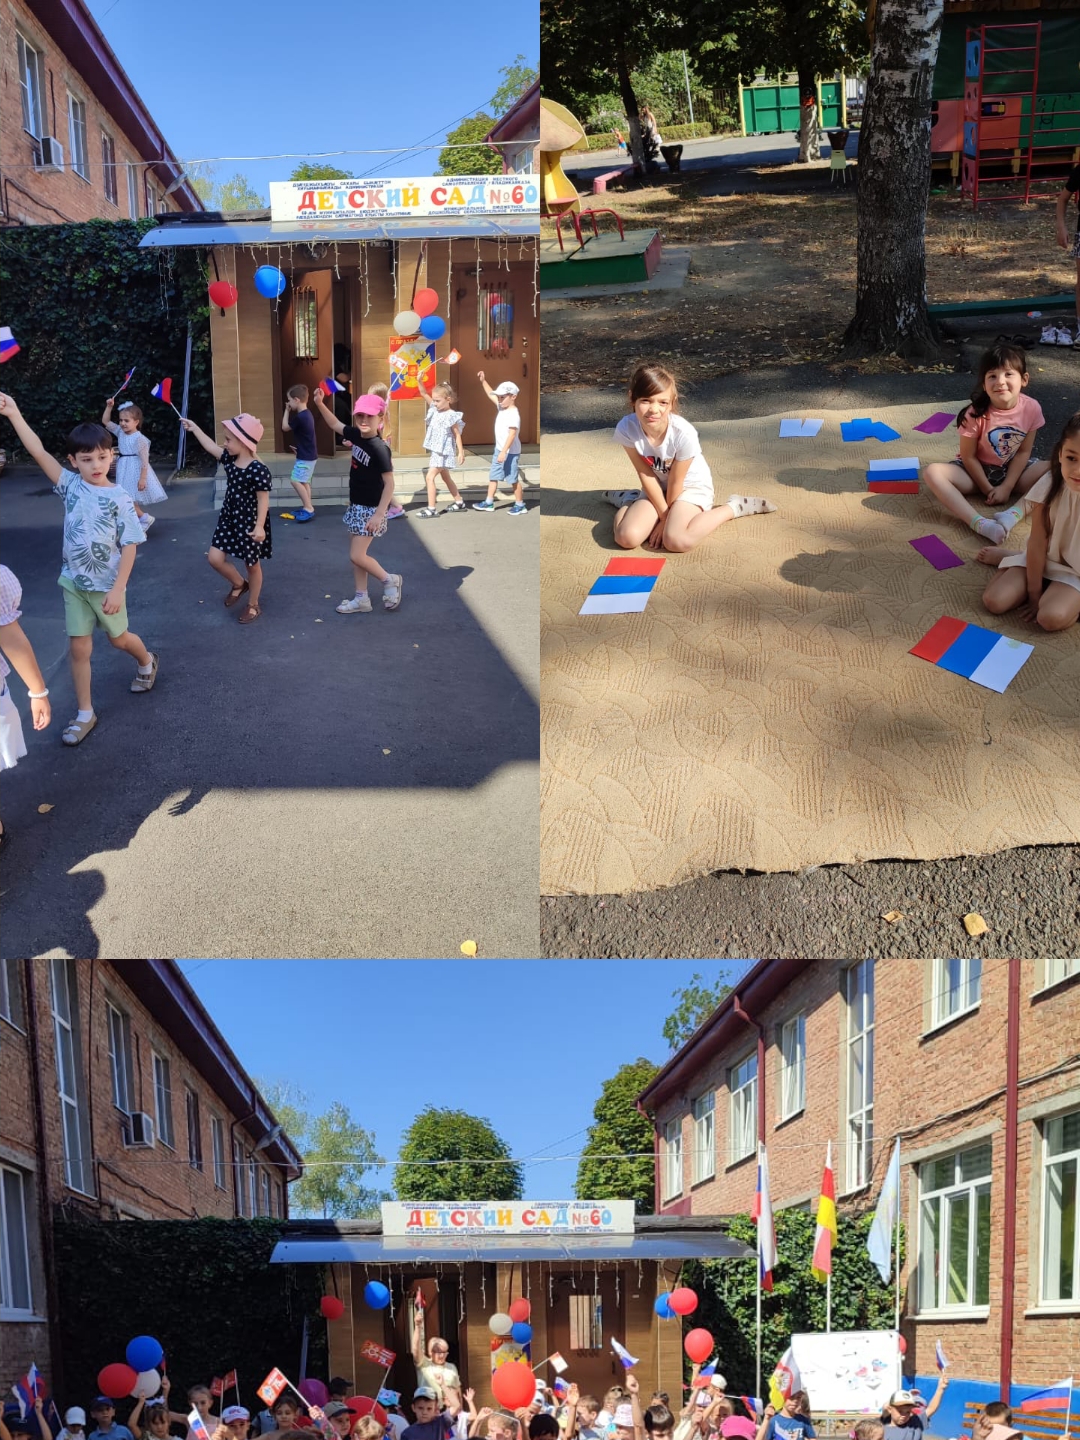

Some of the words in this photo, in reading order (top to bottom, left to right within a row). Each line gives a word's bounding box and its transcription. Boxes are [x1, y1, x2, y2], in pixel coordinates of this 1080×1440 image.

[297, 182, 420, 212] ДЕТСКИЙ
[430, 185, 486, 206] САД
[489, 185, 538, 205] №60
[406, 1205, 513, 1228] ДЕТСКИЙ
[521, 1208, 569, 1226] САД
[572, 1209, 612, 1226] №60
